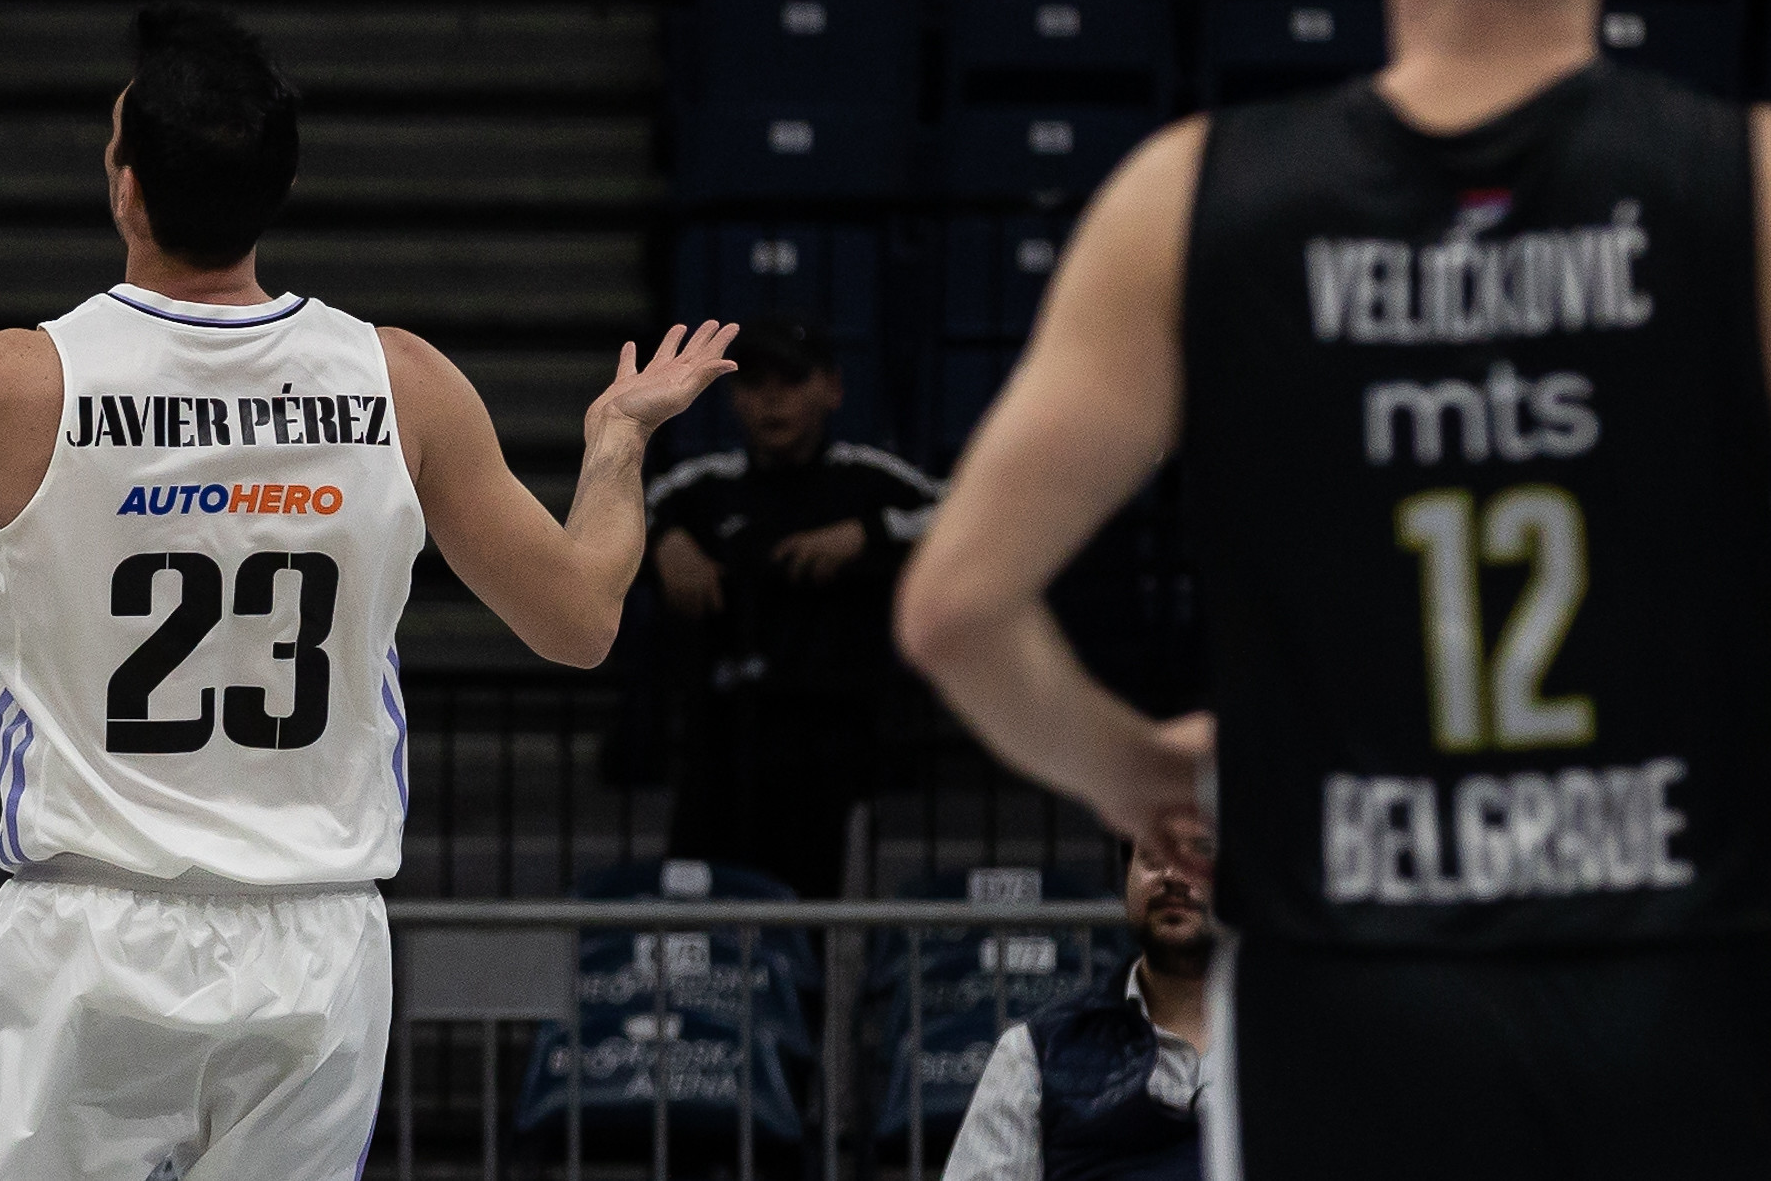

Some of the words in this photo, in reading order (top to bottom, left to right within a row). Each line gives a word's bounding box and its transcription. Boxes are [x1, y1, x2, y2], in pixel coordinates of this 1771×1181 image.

[66, 395, 231, 447] JAVIER
[238, 383, 391, 446] PÉREZ
[1362, 359, 1602, 466] mts
[116, 483, 343, 515] AUTOHERO
[105, 551, 339, 754] 23
[1392, 482, 1598, 755] 12
